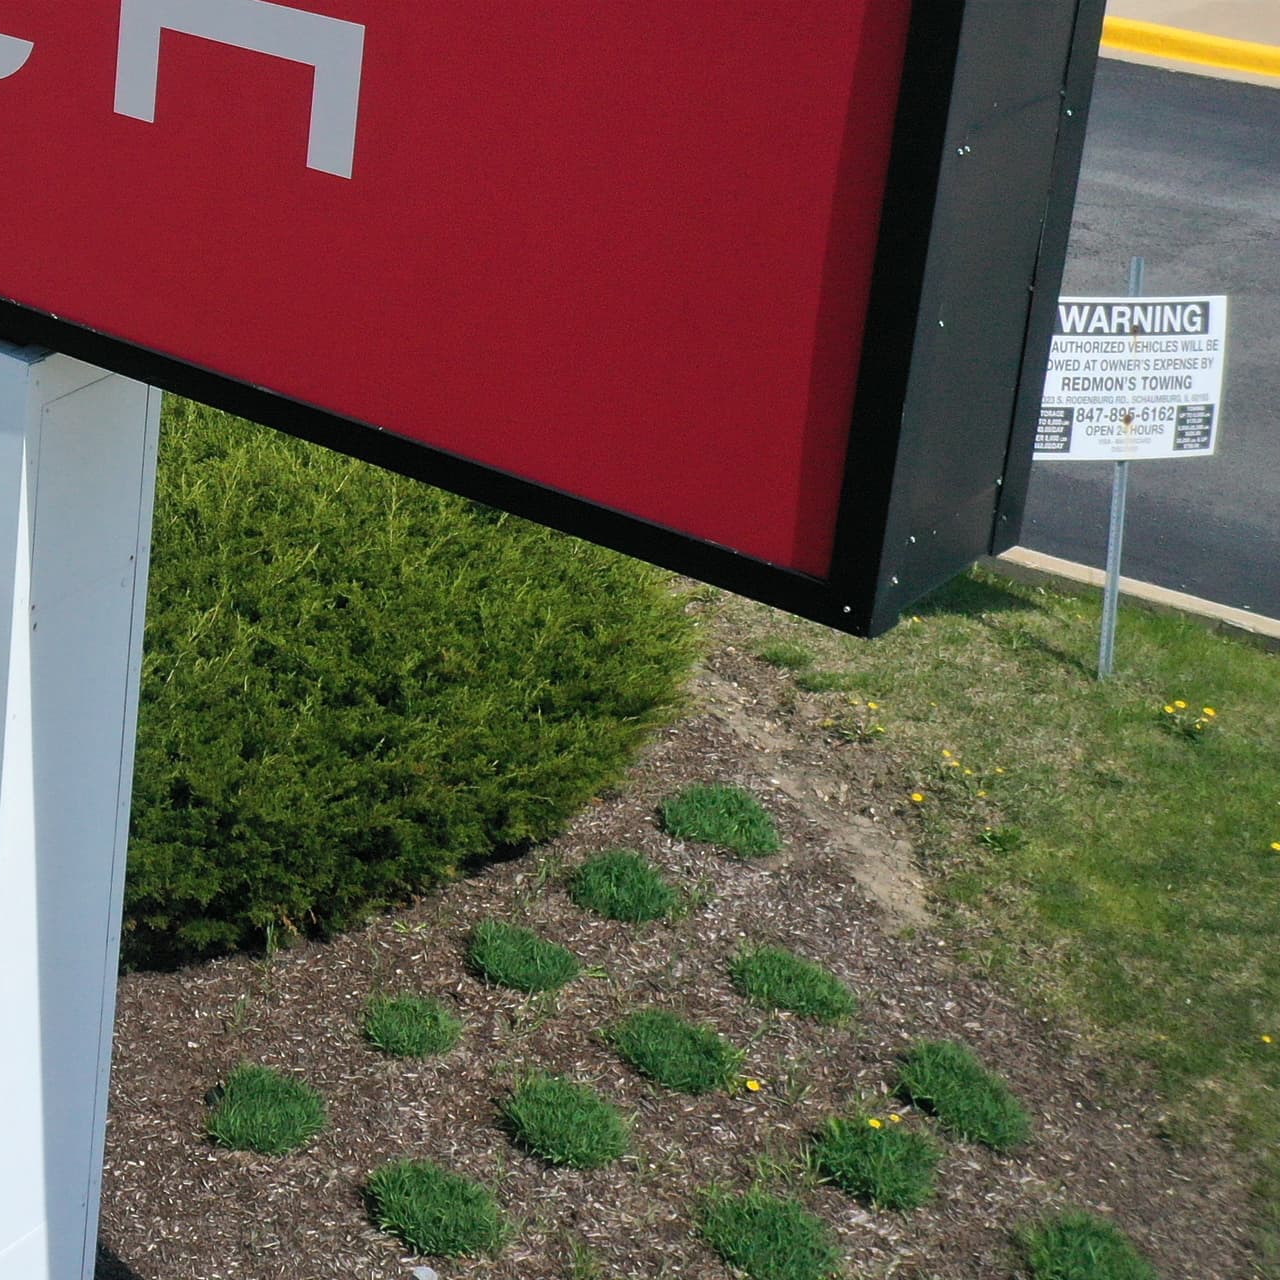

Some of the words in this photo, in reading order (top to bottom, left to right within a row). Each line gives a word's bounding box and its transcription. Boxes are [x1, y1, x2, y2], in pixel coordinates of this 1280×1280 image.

[1058, 304, 1203, 334] WARNING
[1051, 340, 1125, 353] AUTHORIZED
[1128, 340, 1178, 353] VEHICLES
[1180, 339, 1204, 352] WILL
[1205, 339, 1219, 352] BE
[1083, 358, 1098, 372] AT
[1100, 358, 1151, 372] OWNER'S
[1153, 357, 1200, 371] EXPENSE
[1201, 357, 1214, 370] BY
[1061, 376, 1137, 392] REDMON'S
[1141, 375, 1193, 391] TOWING
[1076, 406, 1175, 423] 847-895-6162
[1085, 425, 1115, 437] OPEN
[1130, 424, 1165, 437] HOURS
